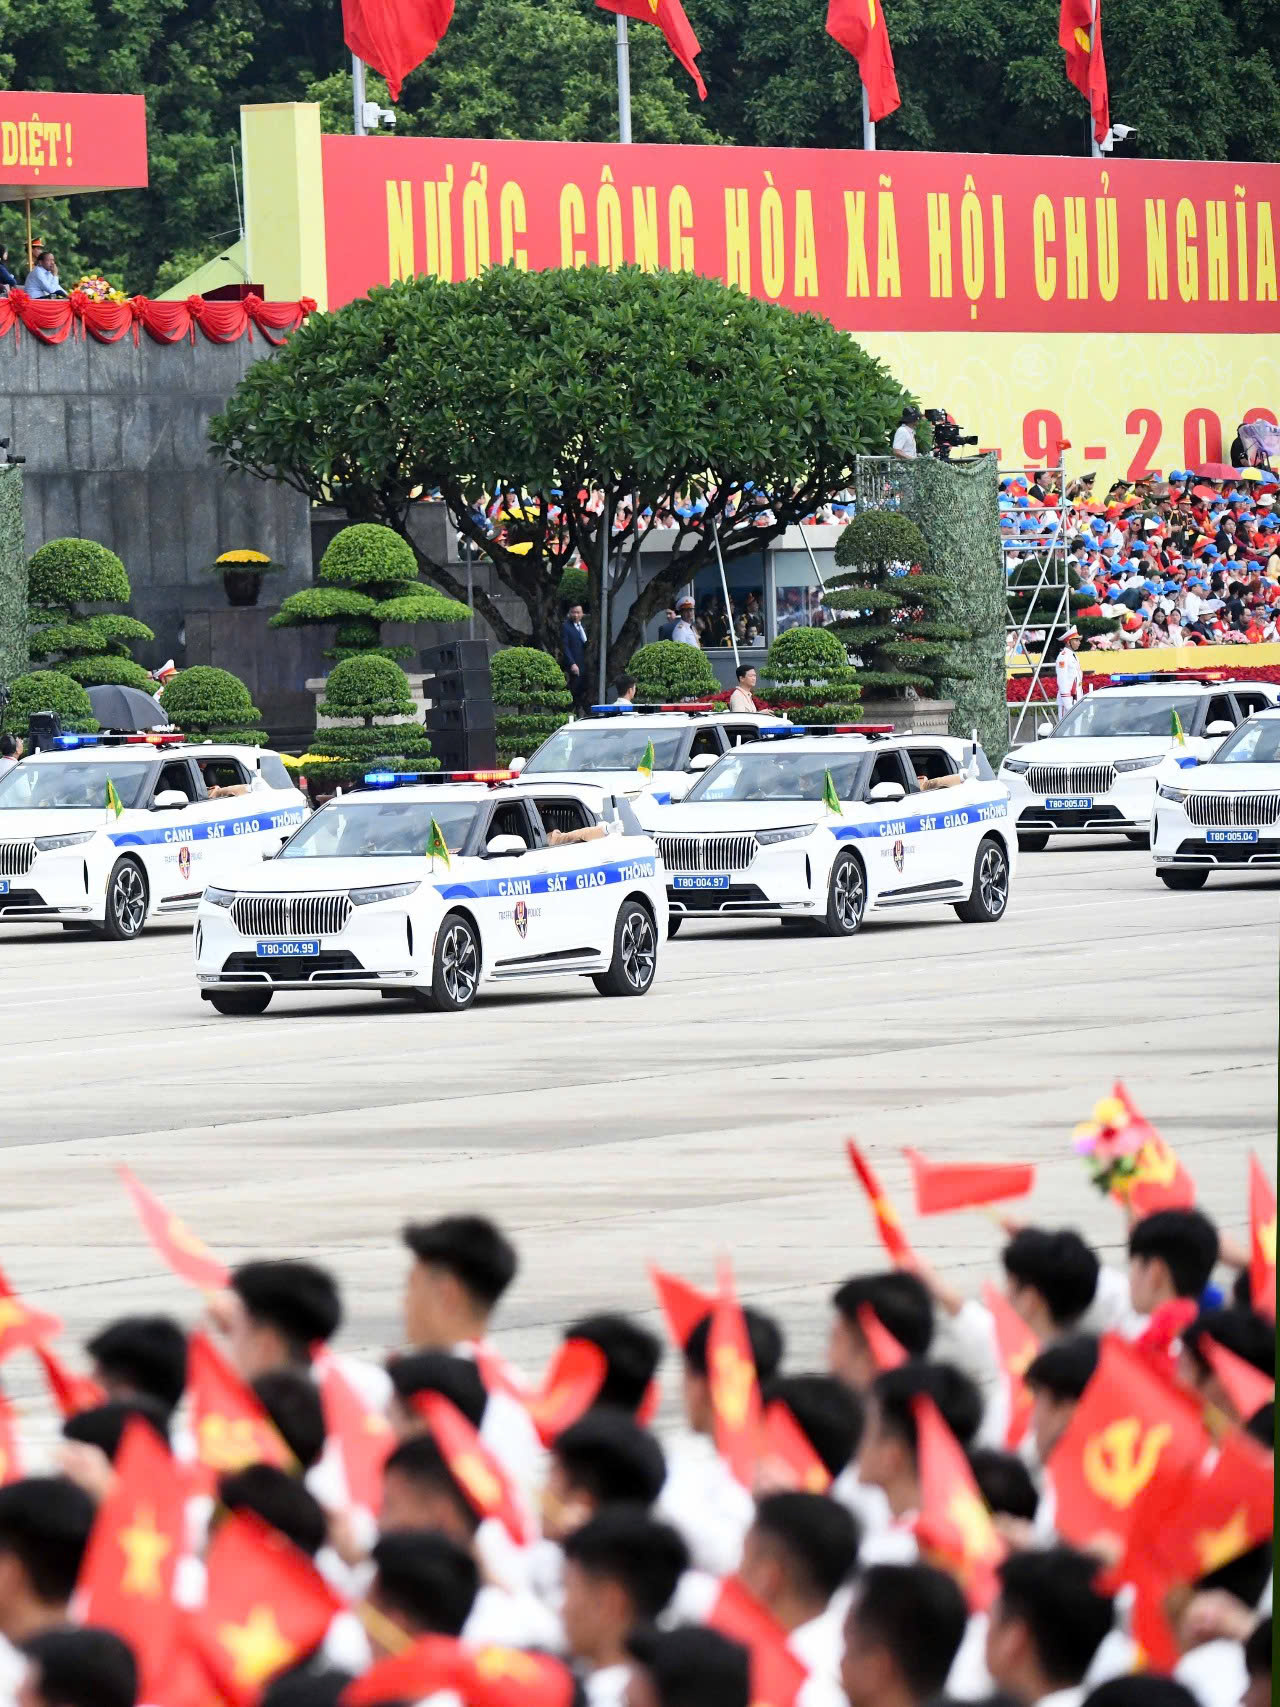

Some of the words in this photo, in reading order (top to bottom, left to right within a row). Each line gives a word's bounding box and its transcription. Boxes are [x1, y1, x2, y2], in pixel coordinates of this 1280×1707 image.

[386, 161, 528, 285] NƯỚC
[560, 164, 695, 275] CÔNG
[724, 170, 819, 299] HÒA
[843, 173, 902, 298] XÃ
[927, 174, 1006, 320] HỘI
[1033, 171, 1119, 302] CHỦ
[1145, 184, 1278, 302] NGHĨA
[164, 827, 194, 843] CẢNH
[207, 823, 225, 839] SÁT
[233, 819, 260, 835] GIAO
[879, 820, 906, 837] CẢNH
[919, 816, 937, 831] SÁT
[943, 812, 969, 828] GIAO
[977, 803, 1008, 820] THÔNG
[1210, 832, 1254, 841] T80-005.04
[498, 878, 531, 896] CẢNH
[547, 874, 568, 892] SÁT
[576, 871, 606, 889] GIAO
[618, 863, 654, 882] THÔNG
[677, 877, 724, 887] T80-004.97
[261, 943, 315, 955] T80-004.99
